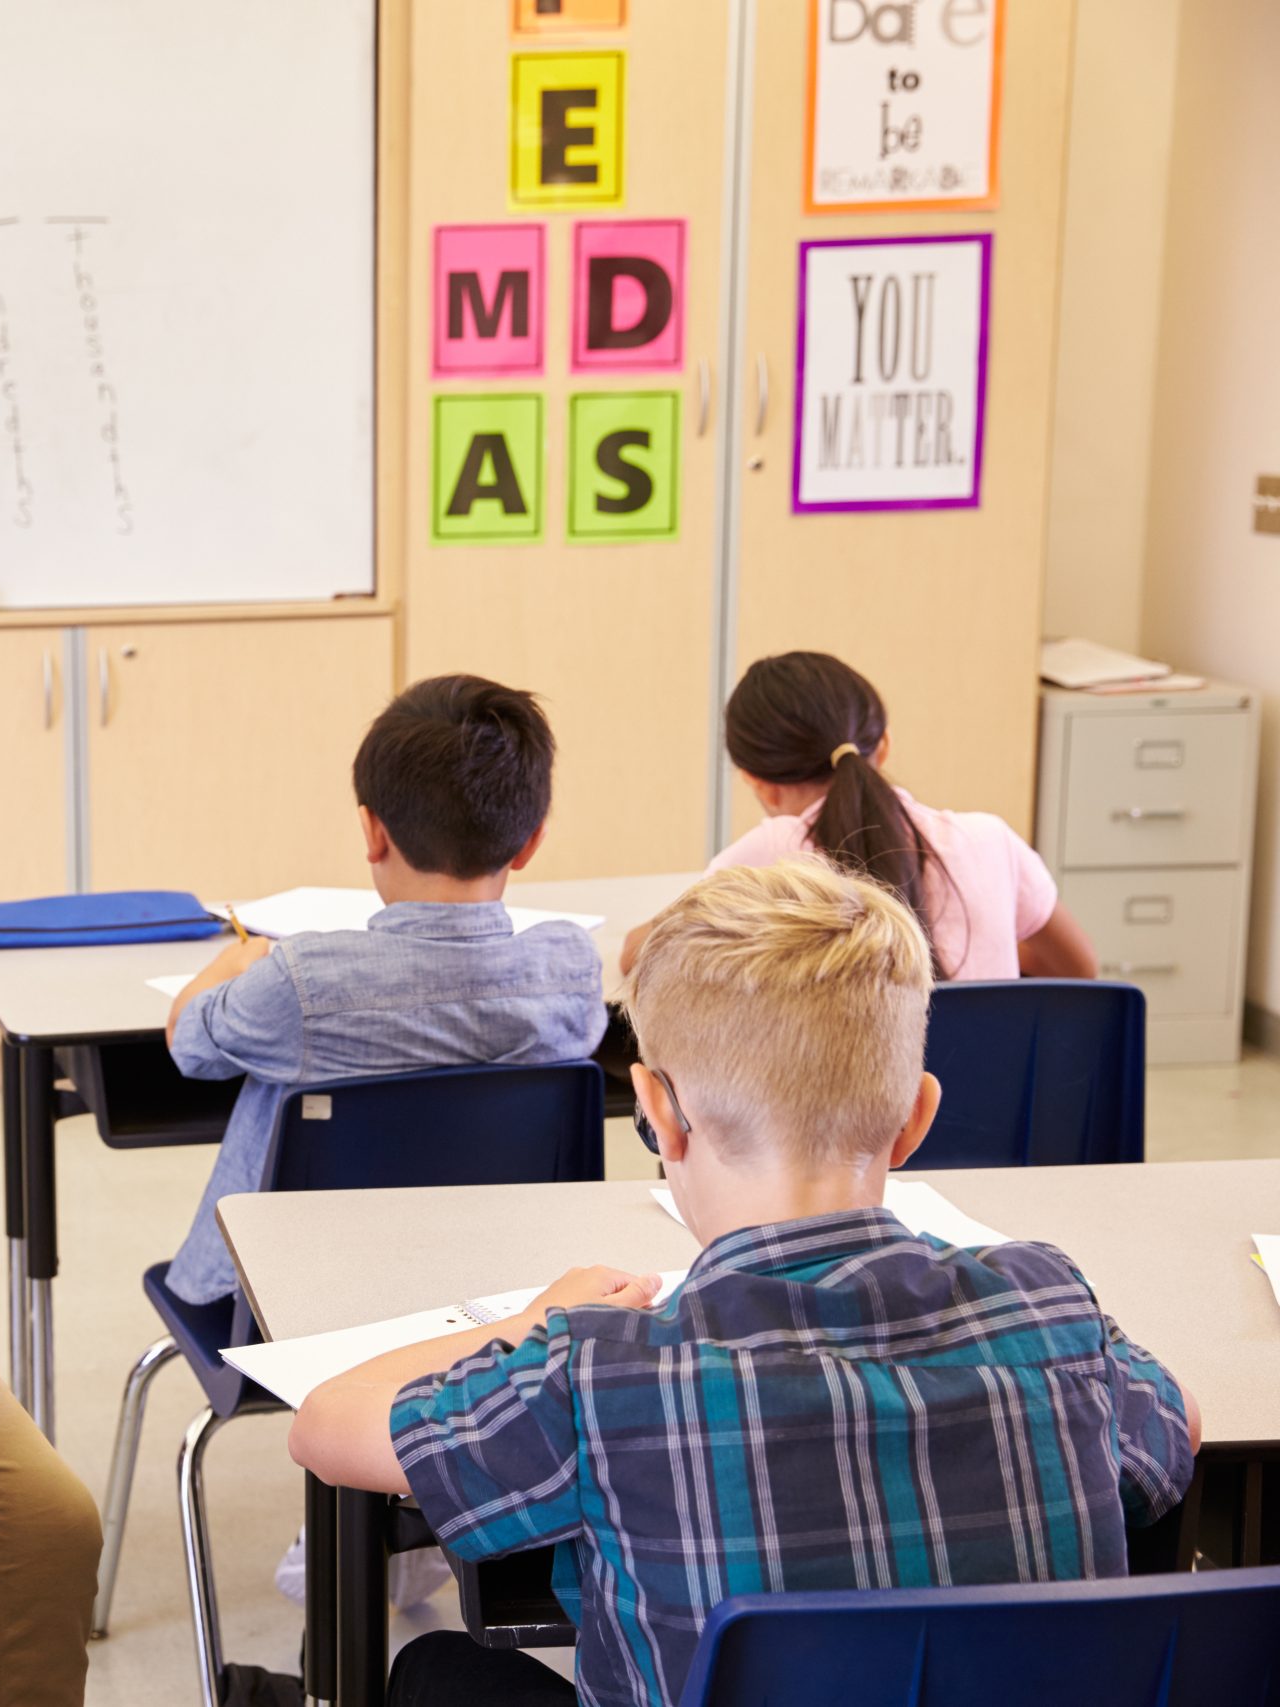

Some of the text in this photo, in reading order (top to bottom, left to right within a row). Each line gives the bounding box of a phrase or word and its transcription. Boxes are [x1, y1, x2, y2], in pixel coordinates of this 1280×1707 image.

[887, 67, 921, 92] to
[539, 87, 598, 186] E
[880, 101, 922, 159] be
[447, 256, 673, 351] M D
[848, 273, 938, 384] YOU
[444, 428, 654, 517] A S
